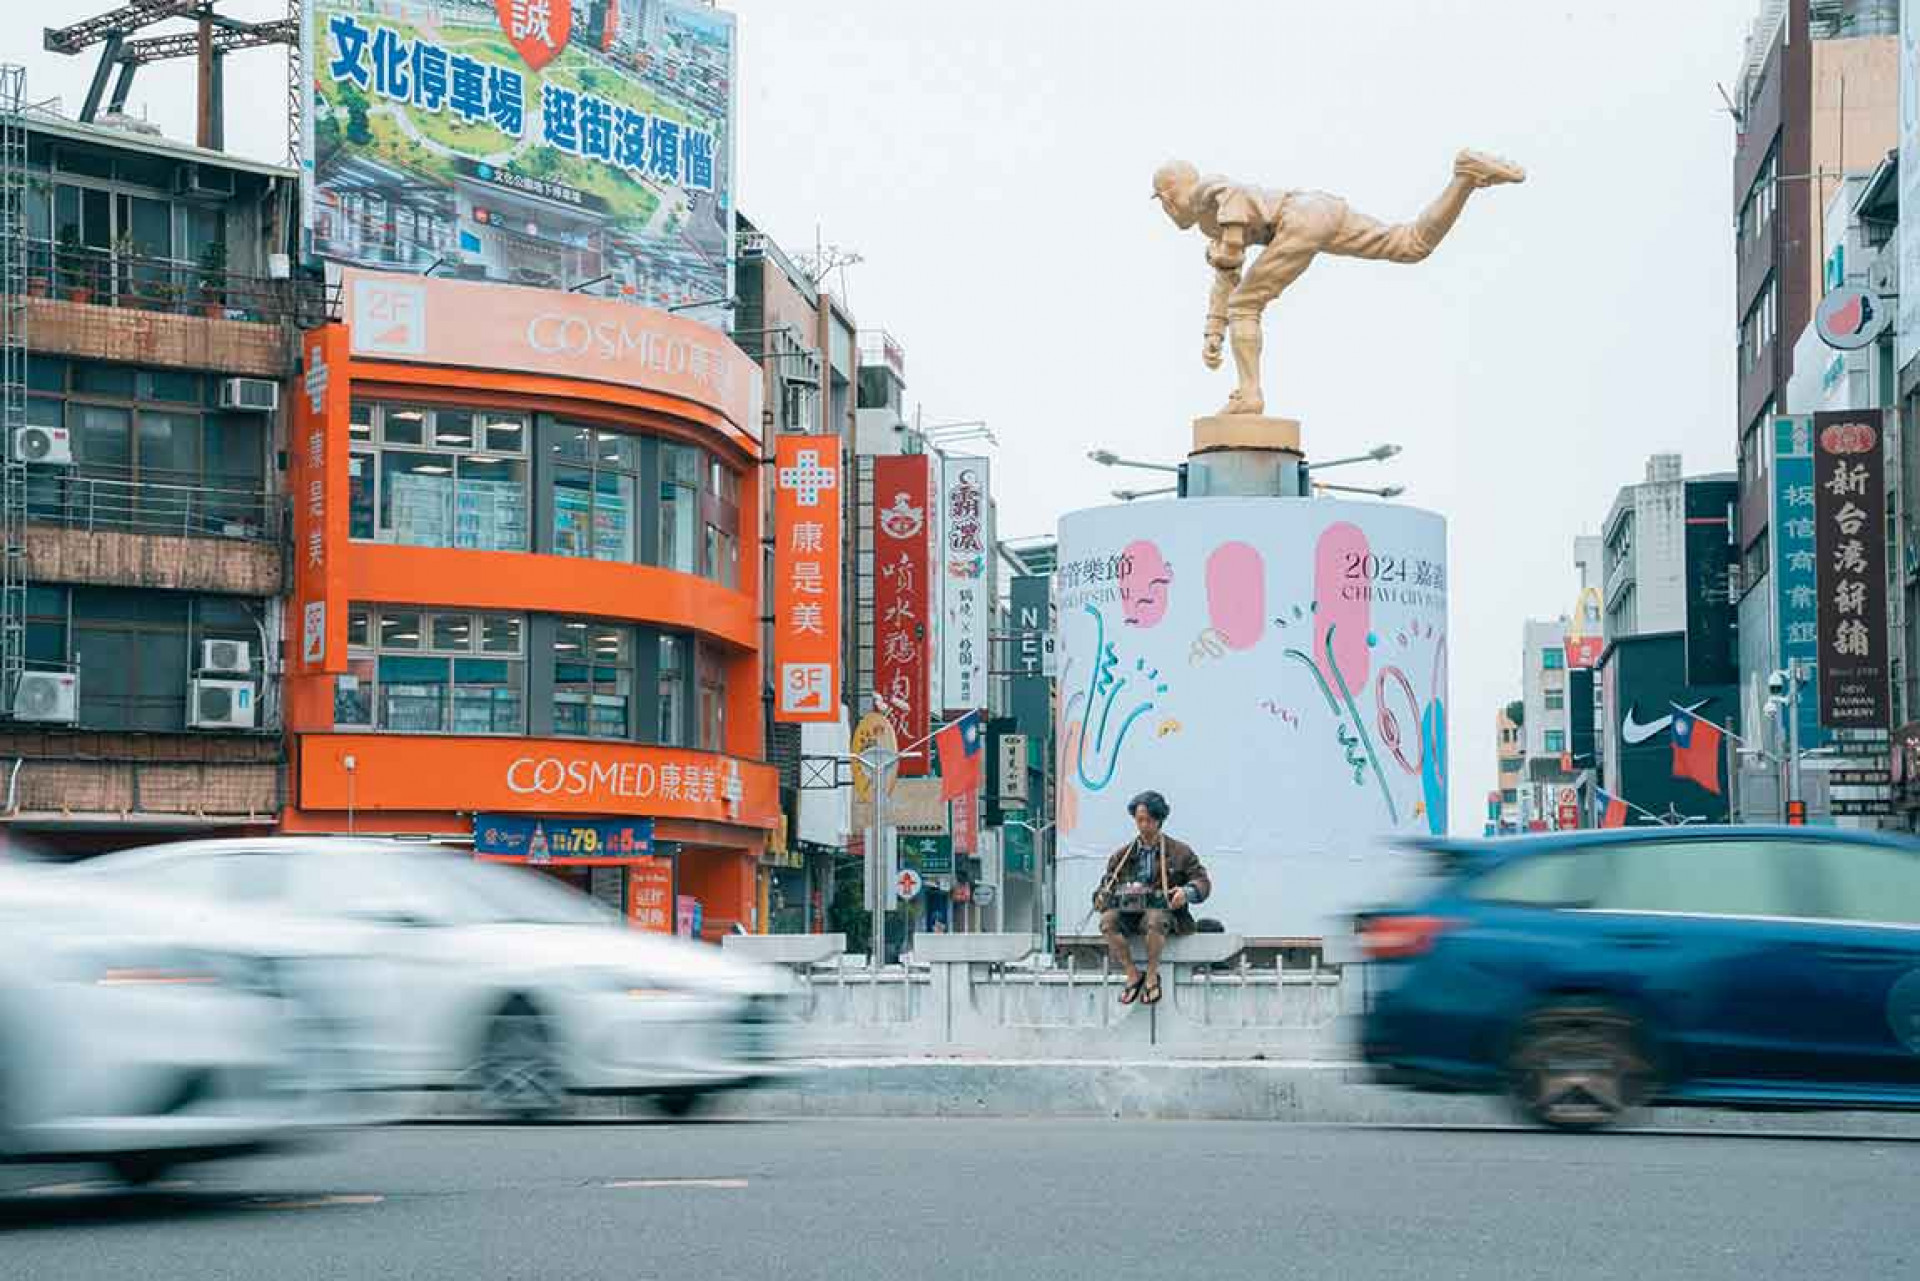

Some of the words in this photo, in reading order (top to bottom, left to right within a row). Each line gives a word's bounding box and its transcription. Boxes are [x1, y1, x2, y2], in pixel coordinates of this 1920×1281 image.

[511, 0, 556, 48] 誠
[329, 15, 524, 137] 文化停車場
[542, 83, 718, 192] 逛街沒煩惱
[367, 290, 413, 321] 2F
[527, 313, 685, 376] COSMED
[791, 520, 826, 636] 康是美
[1345, 552, 1405, 582] 2024
[789, 668, 823, 691] 3F
[1832, 707, 1875, 718] BAKERY
[507, 756, 655, 798] COSMED
[659, 762, 722, 802] 康是美
[570, 827, 597, 851] 79
